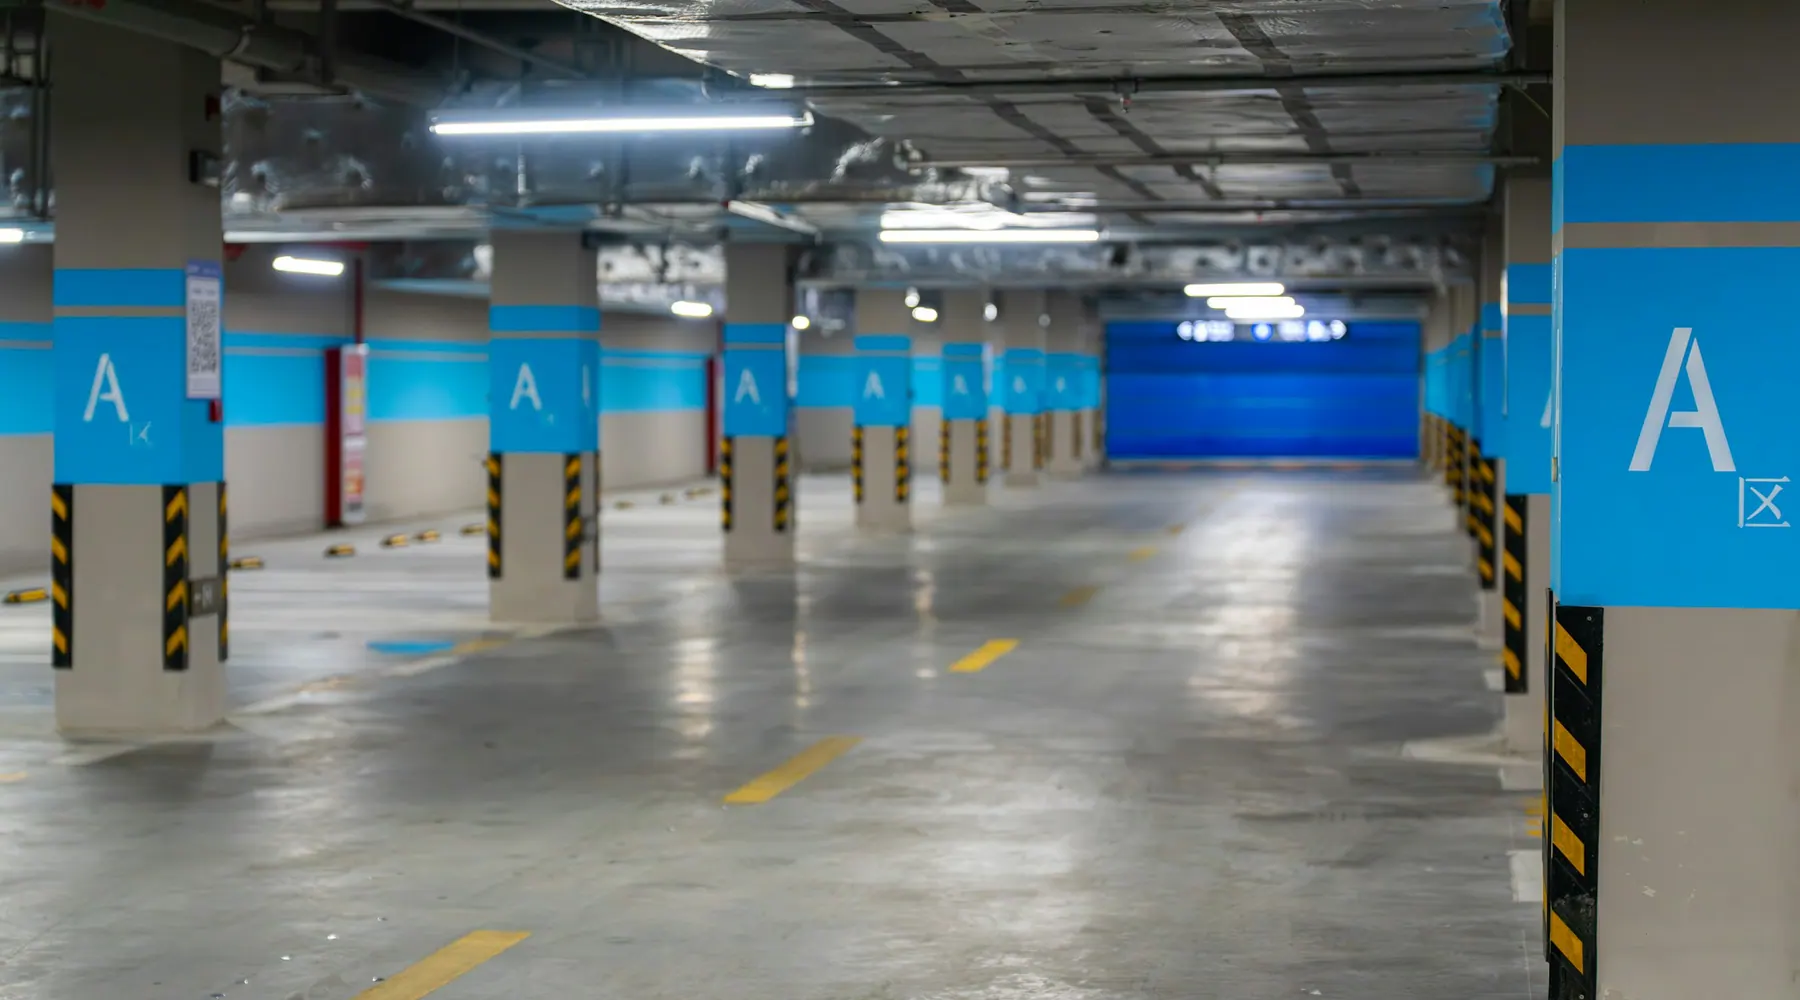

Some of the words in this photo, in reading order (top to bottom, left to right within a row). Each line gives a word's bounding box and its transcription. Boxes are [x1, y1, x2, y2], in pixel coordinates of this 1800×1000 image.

[83, 353, 129, 422] A
[509, 363, 542, 411] A
[734, 368, 760, 404] A
[863, 370, 885, 399] A
[1628, 327, 1737, 472] A
[1738, 476, 1791, 528] 区
